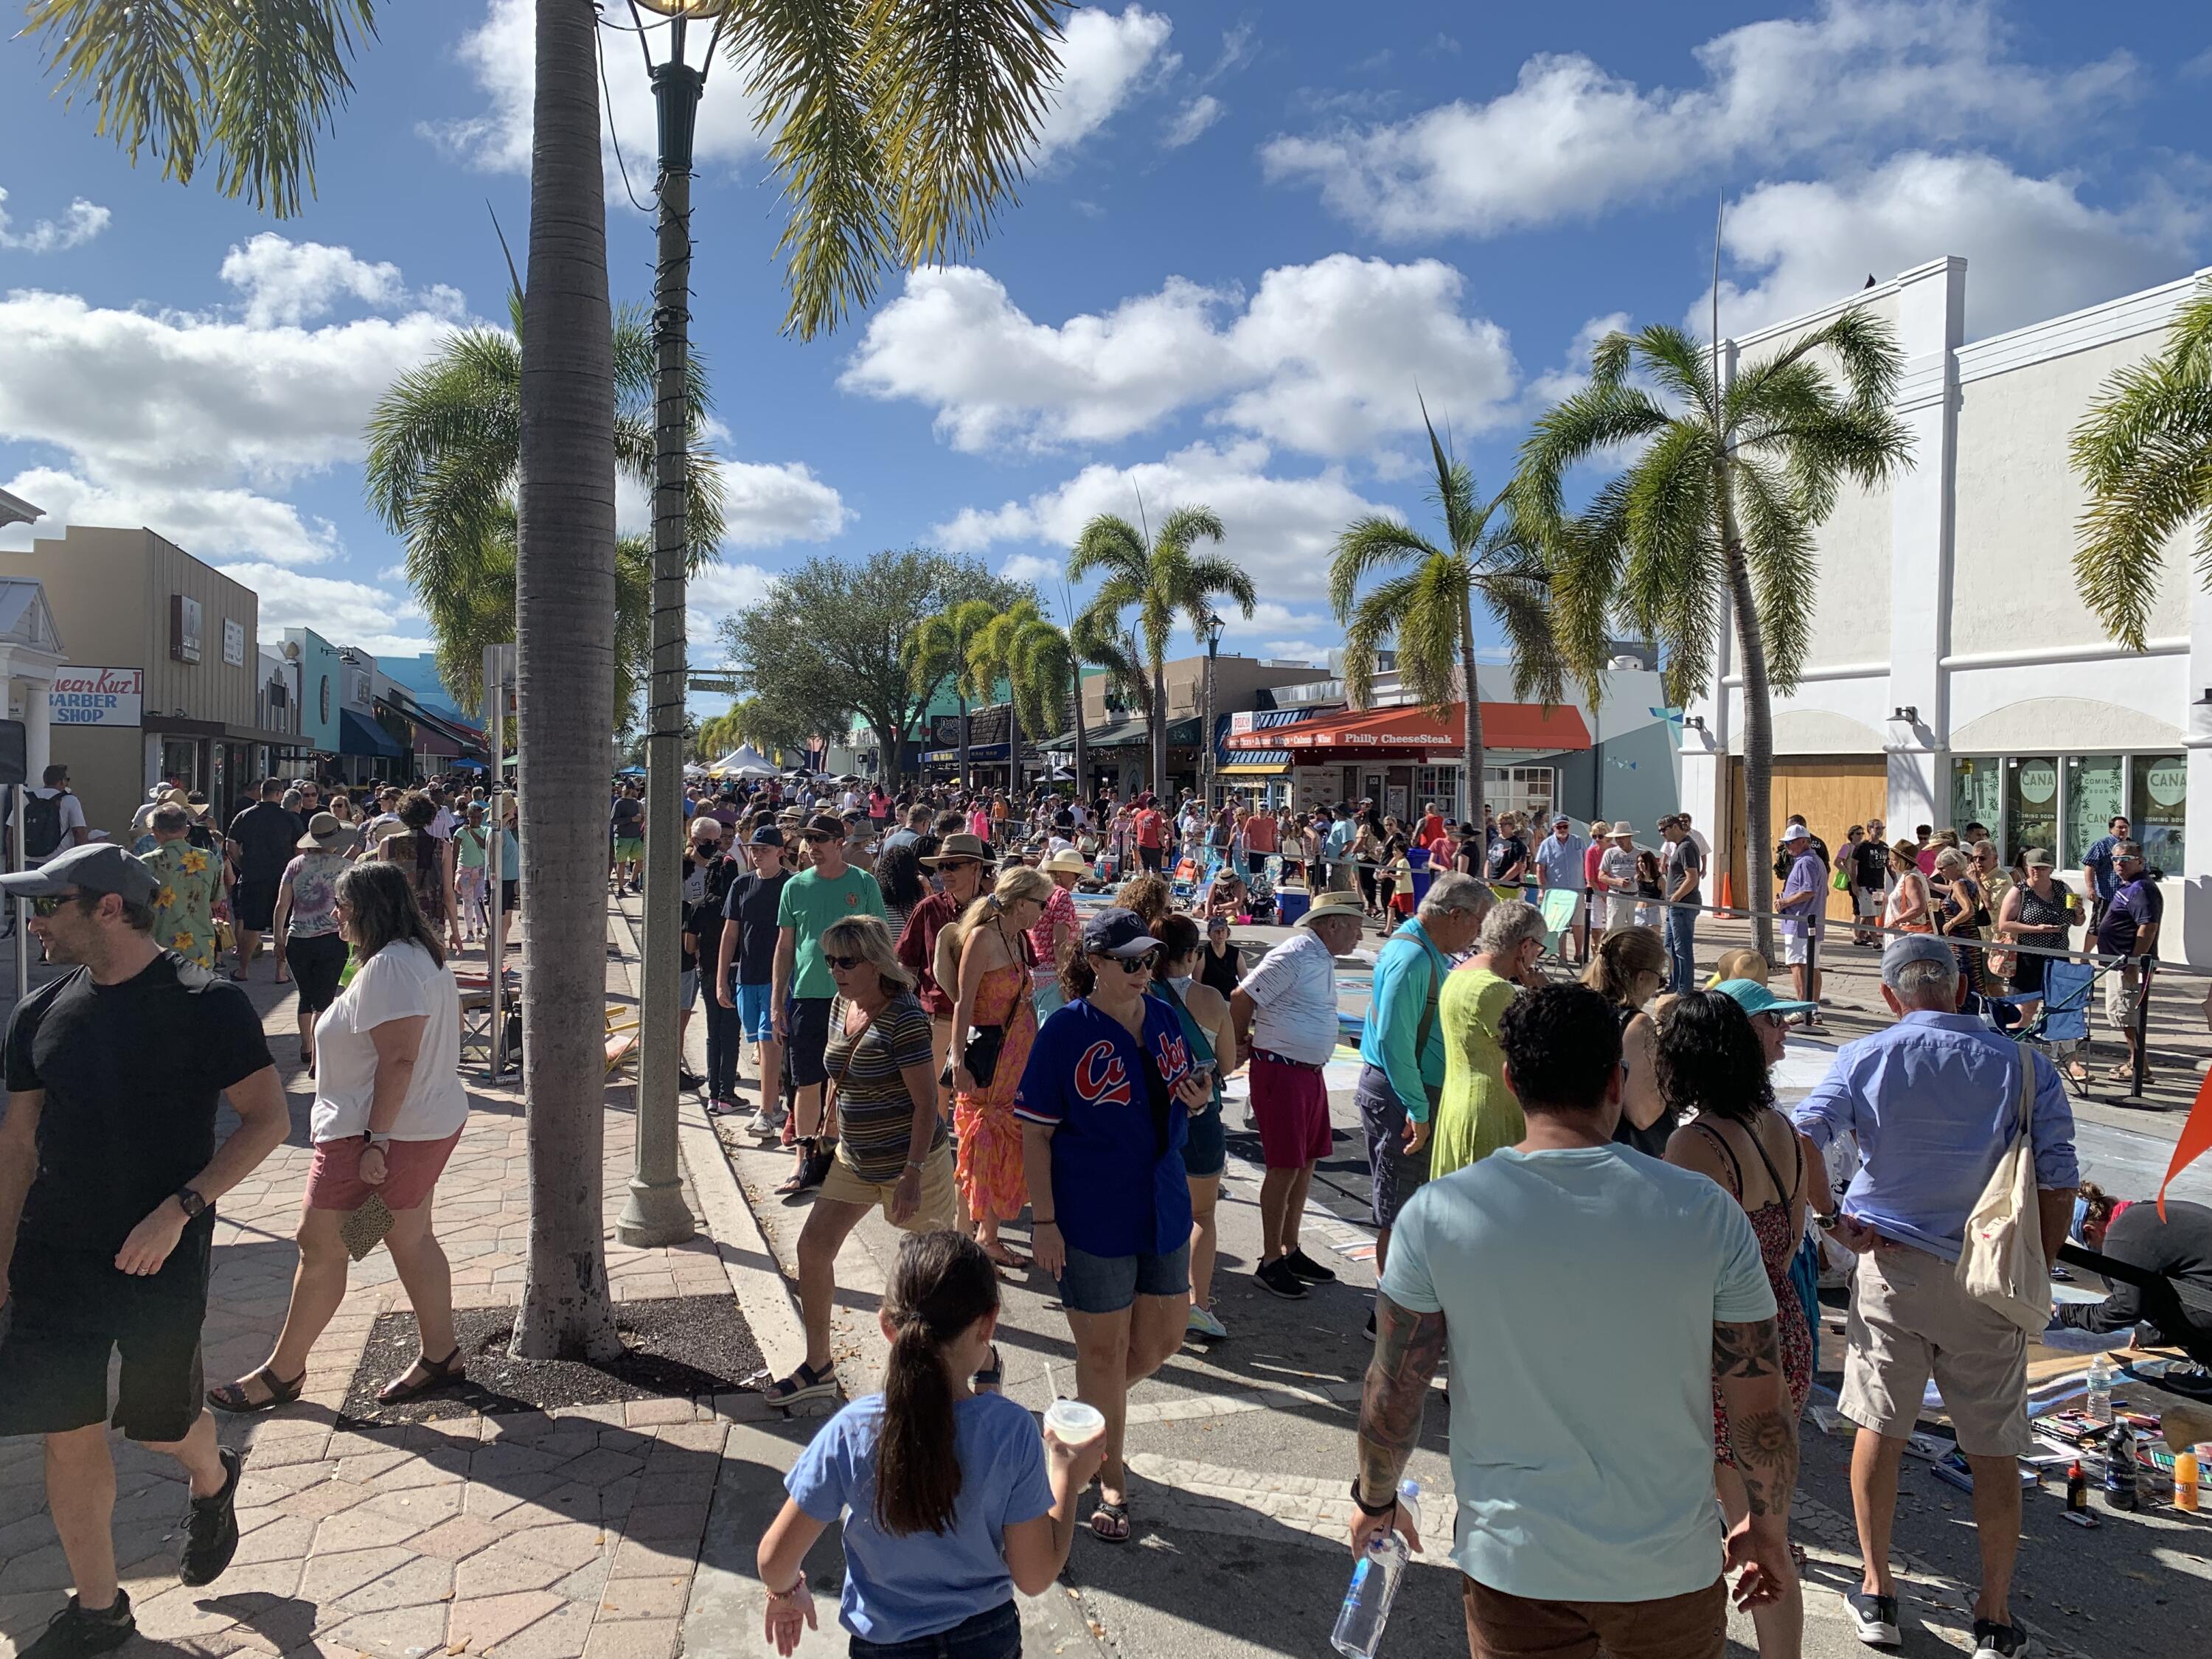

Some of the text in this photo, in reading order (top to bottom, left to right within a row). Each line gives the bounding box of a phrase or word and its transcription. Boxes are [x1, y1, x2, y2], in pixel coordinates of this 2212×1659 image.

[58, 708, 104, 723] SHOP
[1317, 734, 1331, 743] Wine
[1345, 734, 1453, 745] Philly CheeseSteak
[2023, 773, 2054, 787] CANA
[2150, 773, 2186, 787] CANA
[1970, 811, 1992, 819] CANA
